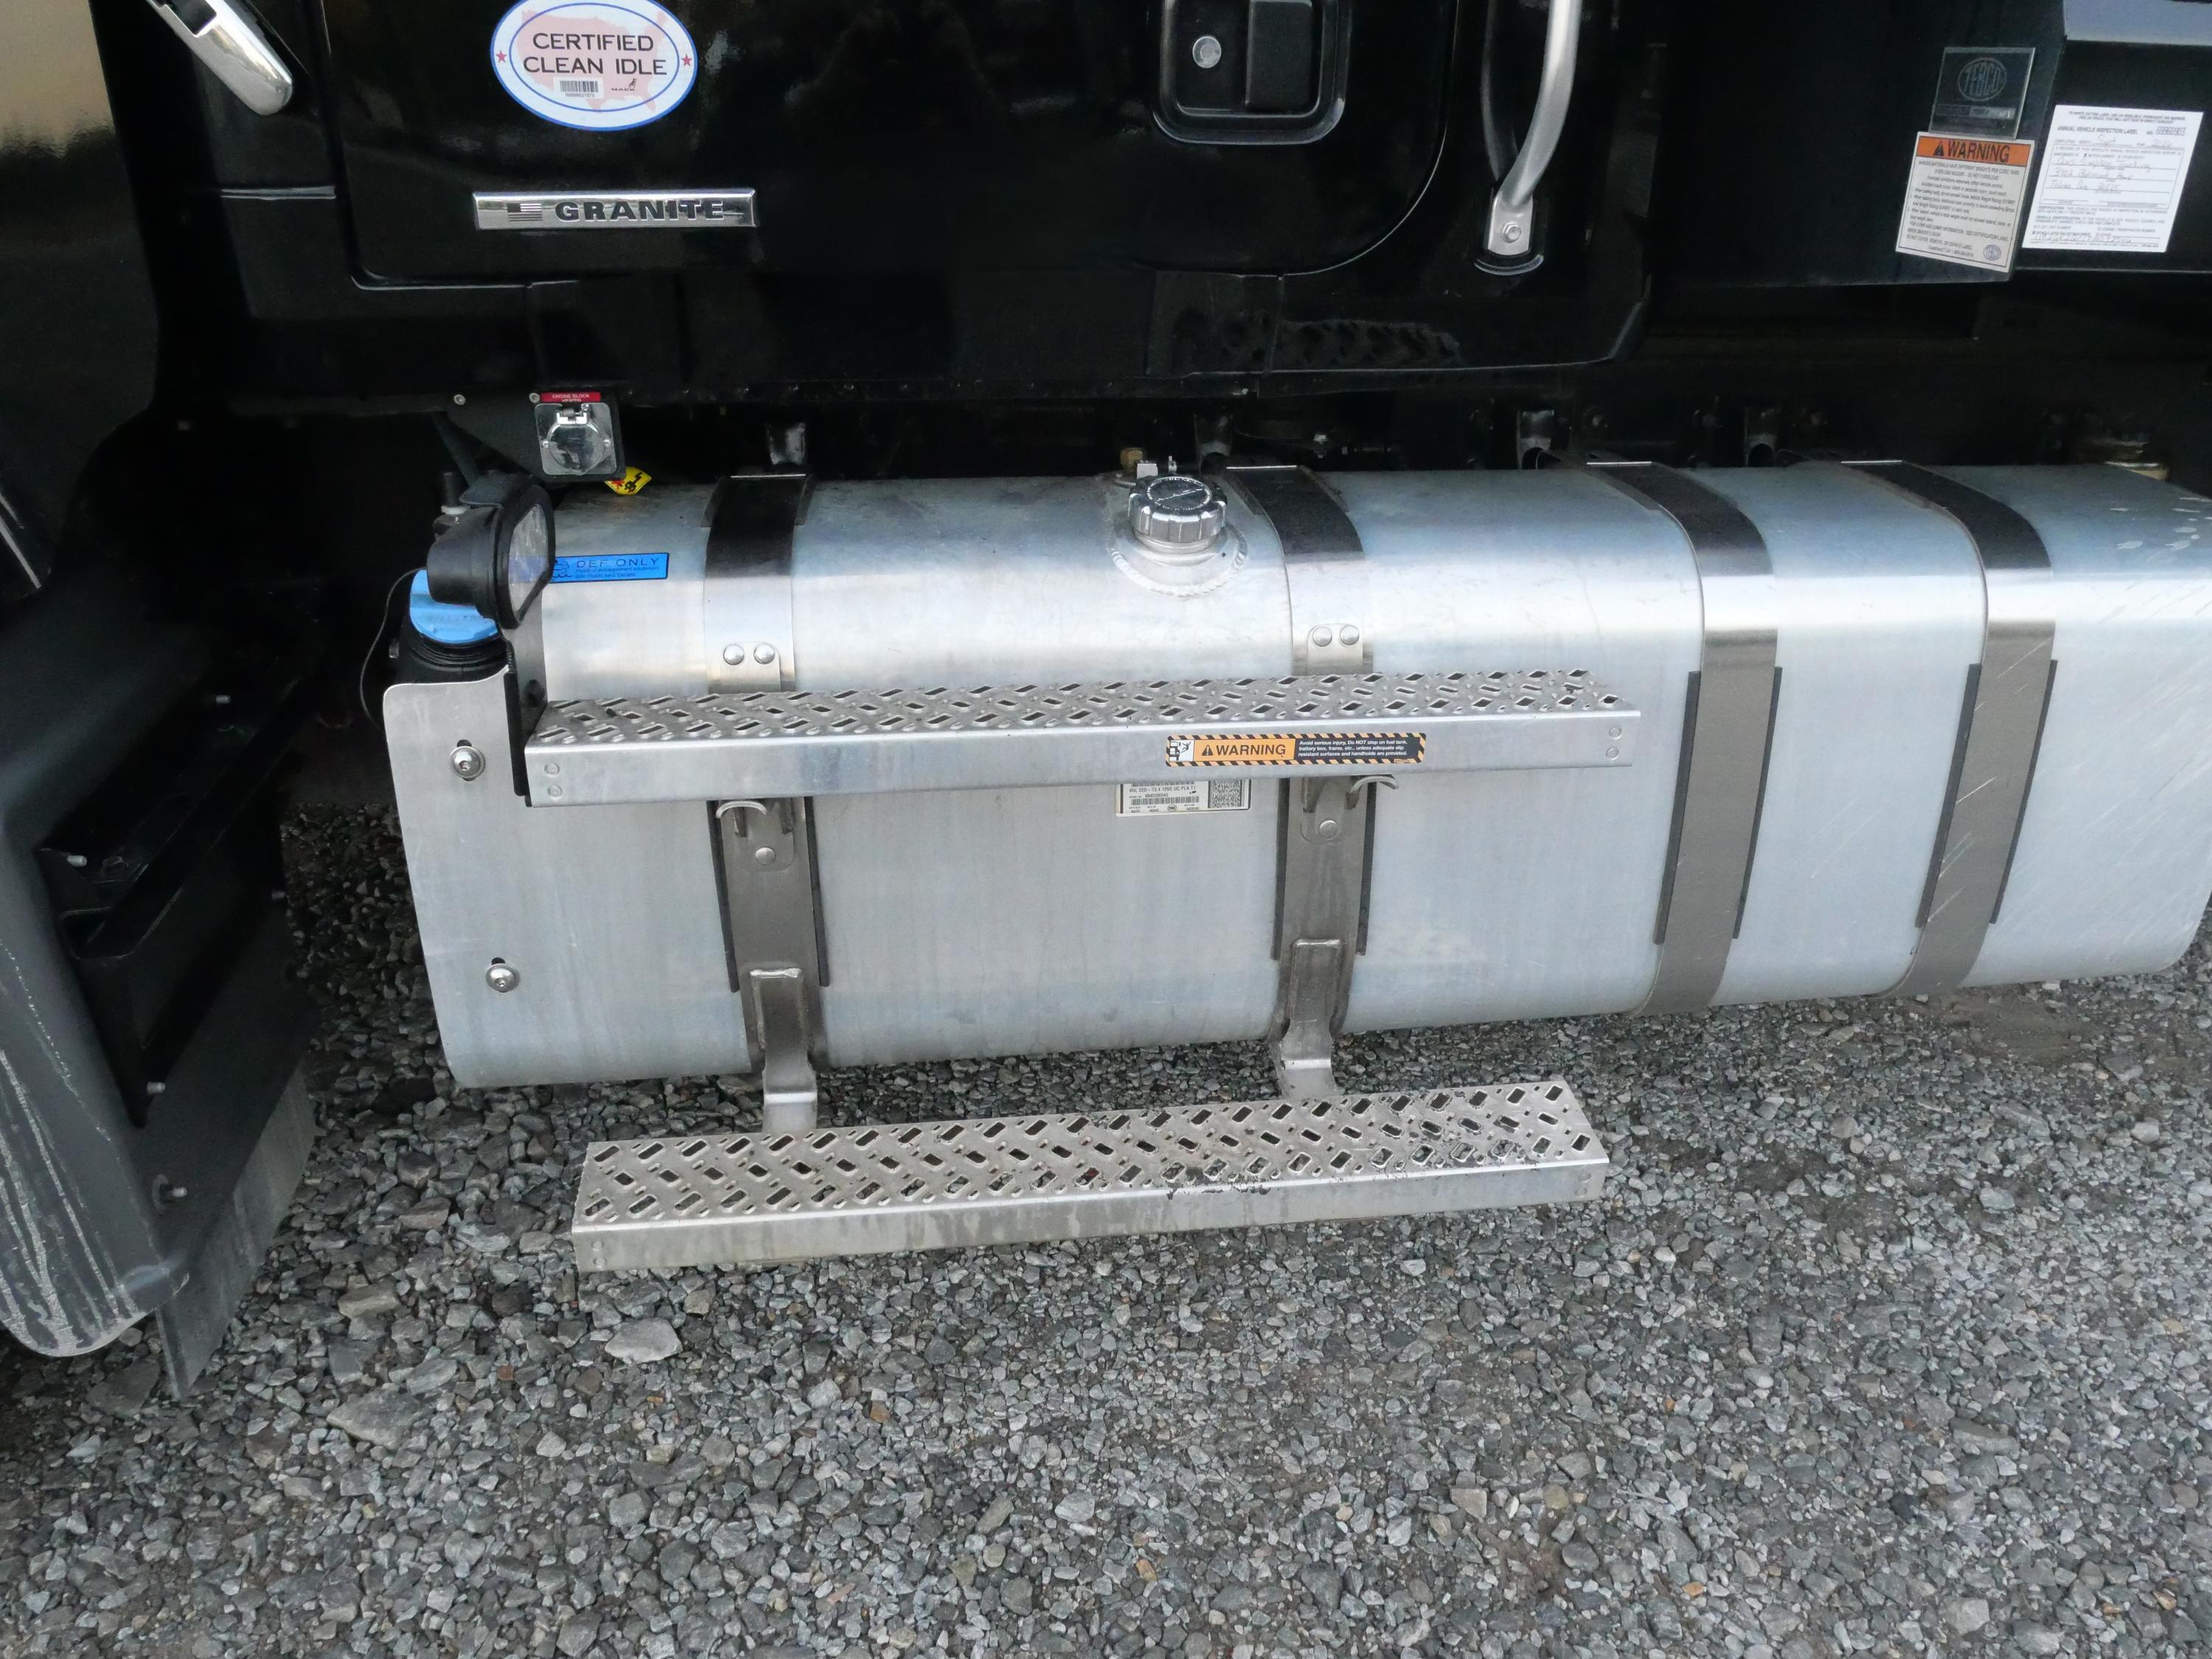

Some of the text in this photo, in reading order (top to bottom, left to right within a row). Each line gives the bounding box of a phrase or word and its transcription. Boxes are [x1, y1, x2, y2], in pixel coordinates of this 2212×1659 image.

[532, 33, 654, 52] CERTIFIED
[523, 56, 667, 75] CLEAN IDLE
[1947, 140, 2009, 163] WARNING
[554, 200, 724, 221] GRANITE
[577, 557, 659, 568] DEF ONLY
[1216, 743, 1286, 756] WARNING
